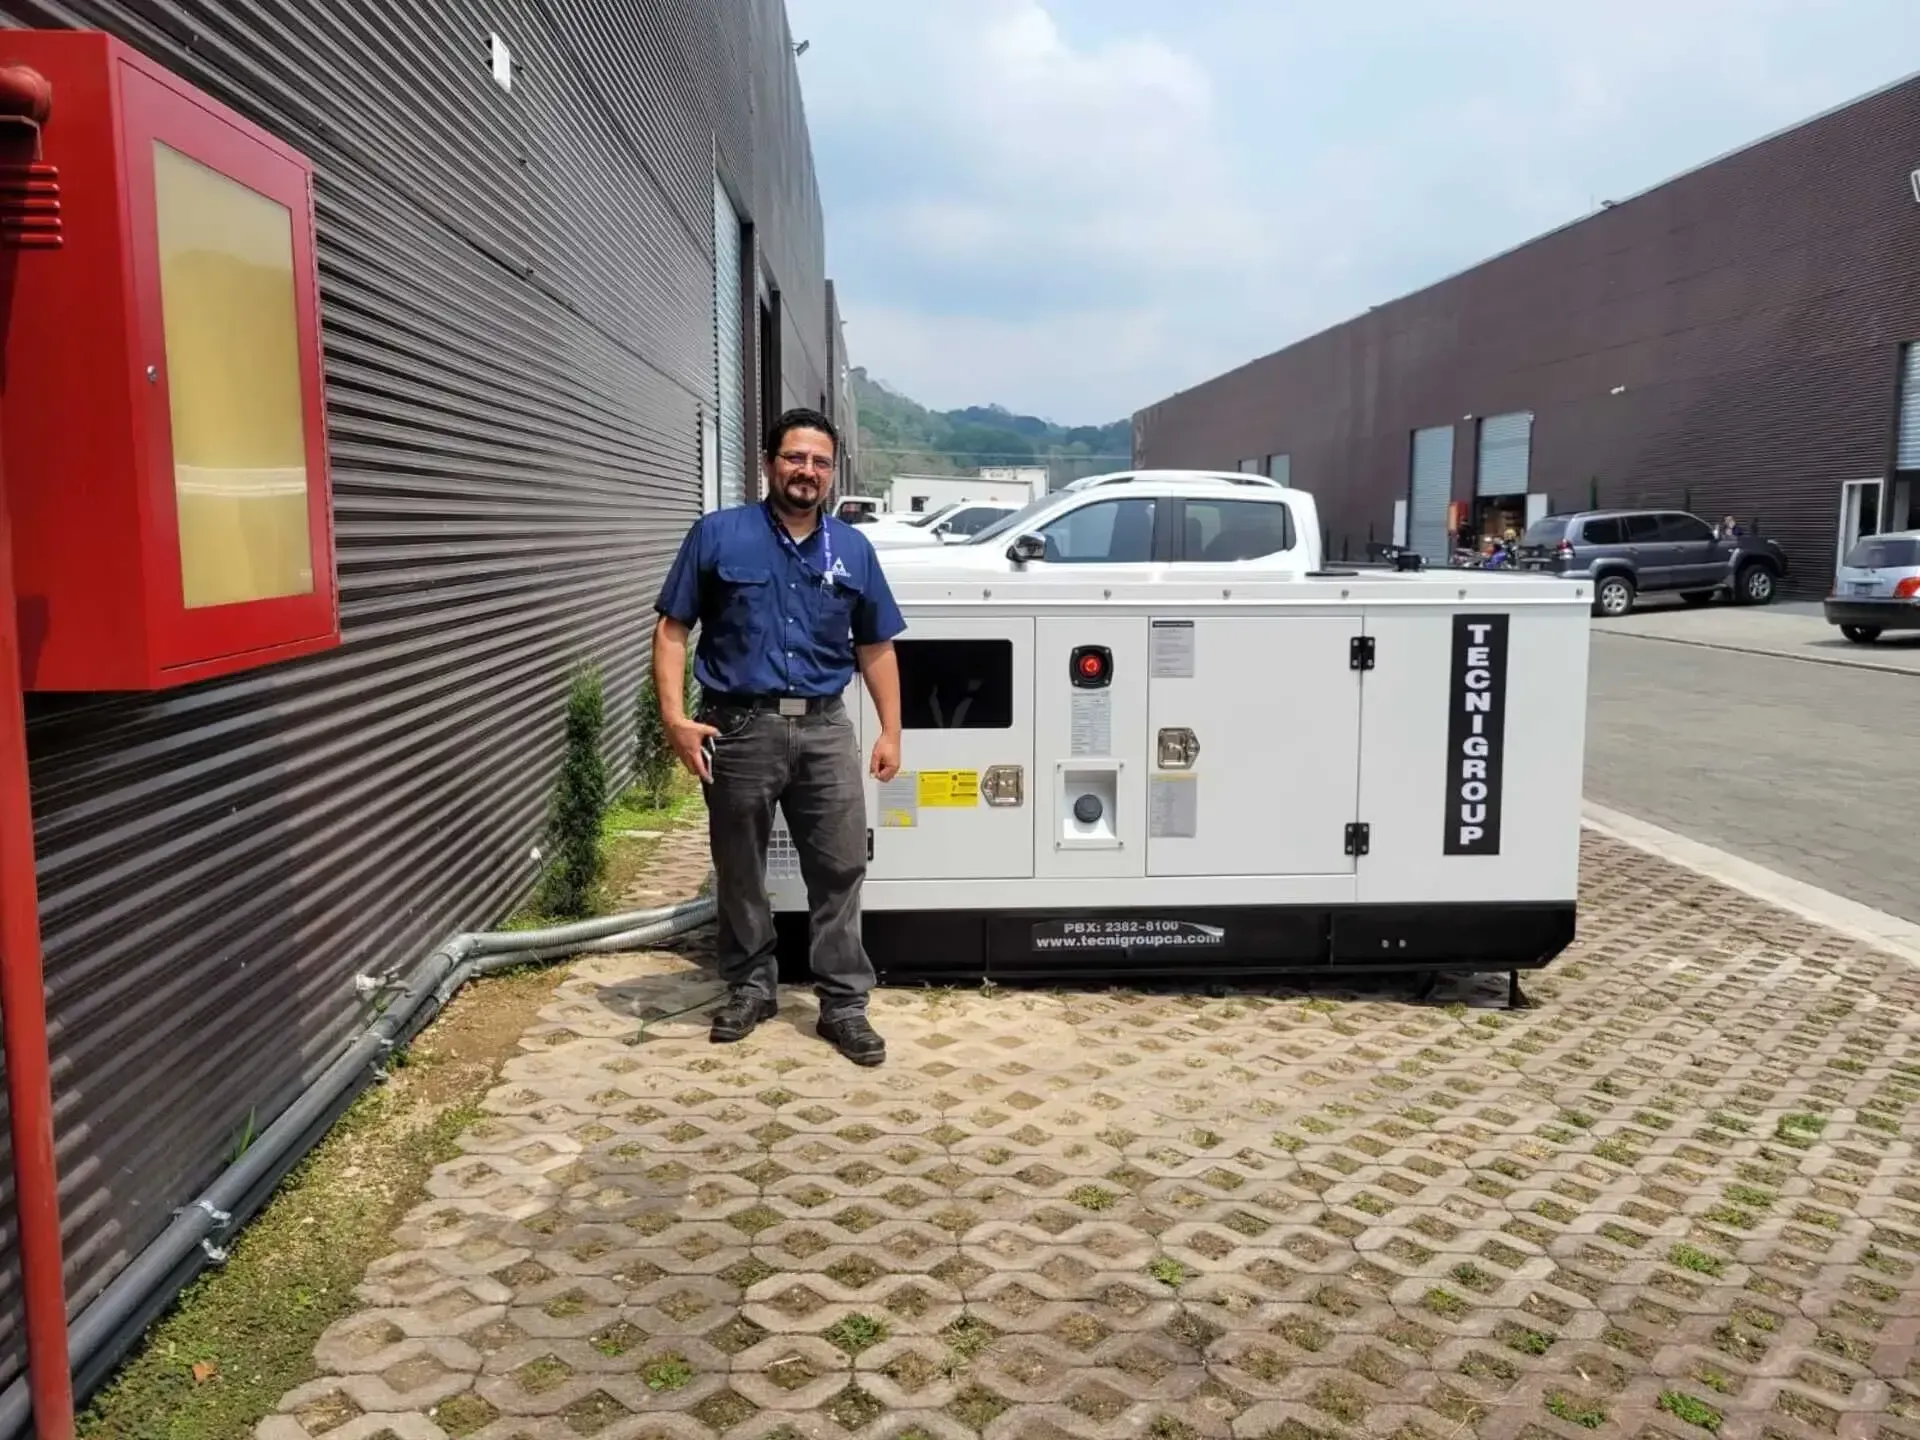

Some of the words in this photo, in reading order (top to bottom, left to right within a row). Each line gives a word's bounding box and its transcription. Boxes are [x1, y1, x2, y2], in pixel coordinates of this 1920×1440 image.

[1459, 624, 1492, 845] TECNIGROUP
[1064, 922, 1101, 933] PBX:
[1105, 920, 1179, 933] 2382-8100
[1036, 934, 1221, 948] www.tecnigroupca.com
